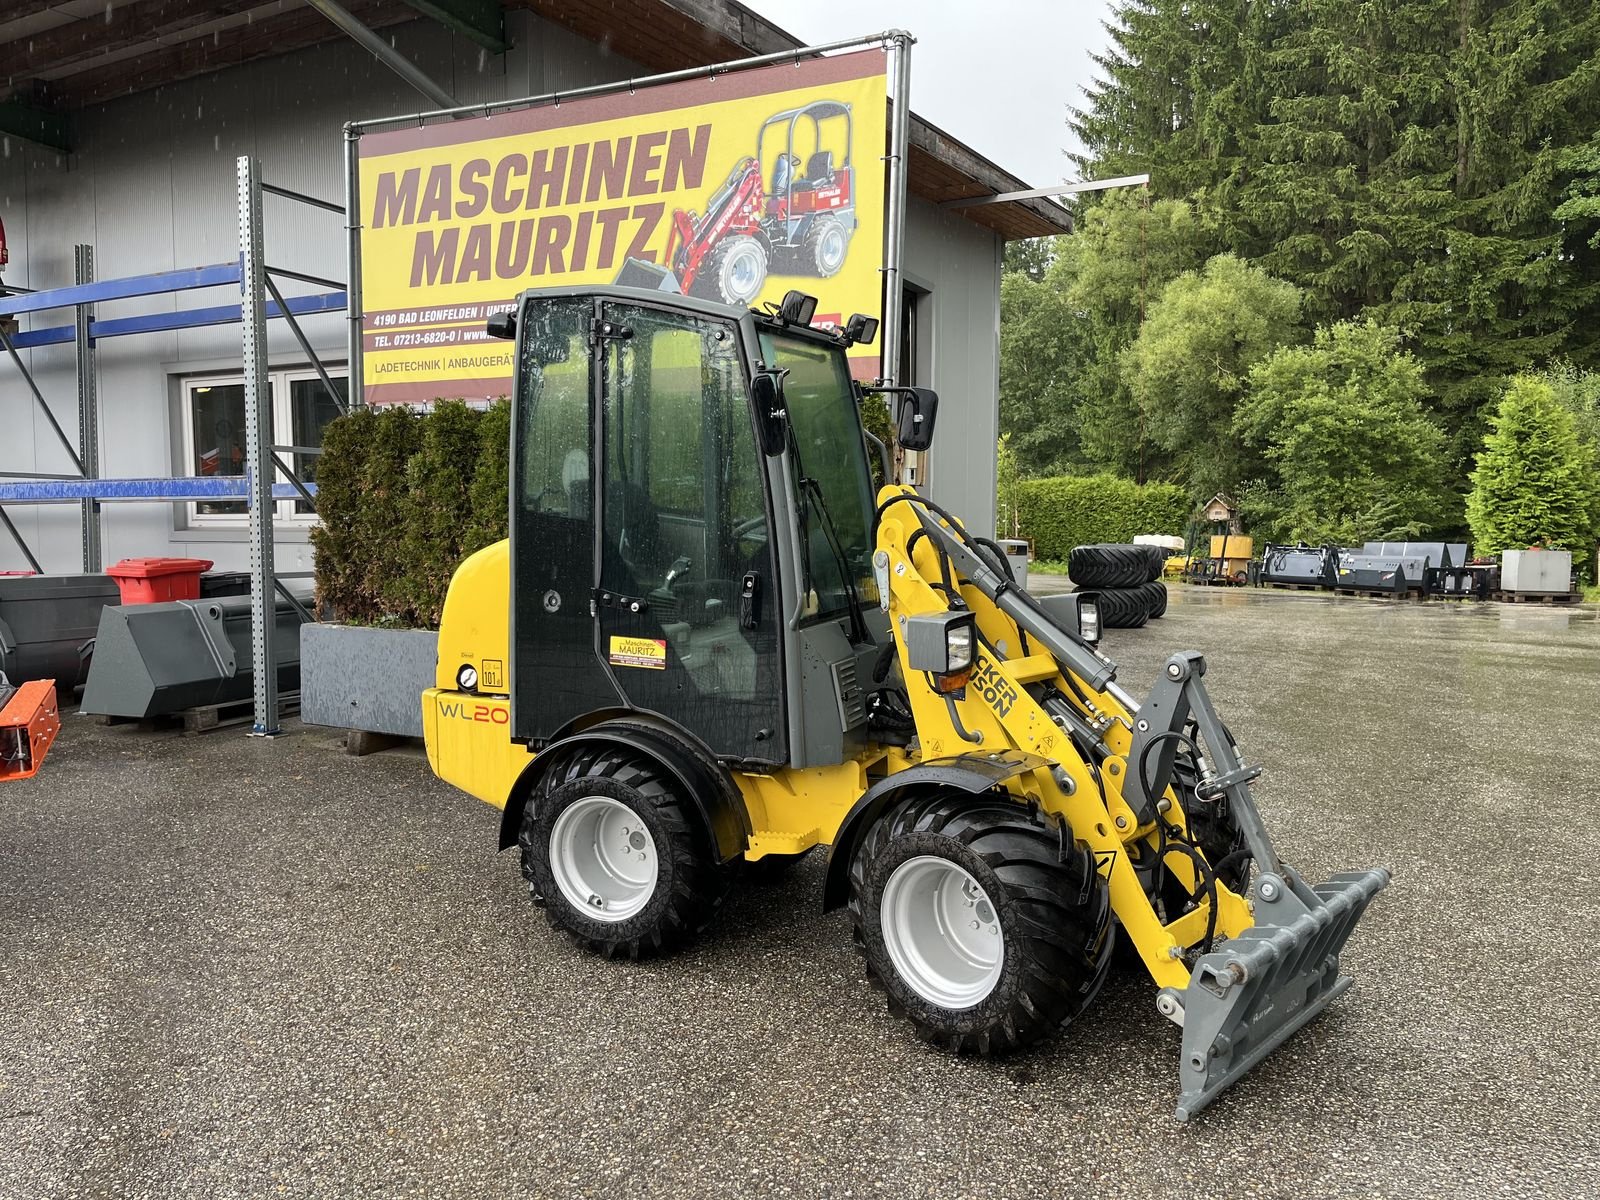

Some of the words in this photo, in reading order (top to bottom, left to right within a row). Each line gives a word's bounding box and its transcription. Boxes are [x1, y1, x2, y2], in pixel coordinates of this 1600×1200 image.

[372, 124, 712, 229] MASCHINEN
[409, 202, 666, 288] MAURITZ
[374, 314, 397, 326] 4190
[399, 312, 417, 324] BAD
[419, 306, 478, 322] LEONFELDEN
[486, 303, 518, 317] UNTER
[375, 336, 391, 347] TEL.
[394, 330, 456, 346] 07213-6820-0
[375, 359, 441, 373] LADETECHNIK
[619, 645, 656, 656] MAURITZ
[484, 671, 496, 685] 101
[976, 655, 1018, 707] CKER
[969, 671, 1011, 719] SON
[439, 701, 509, 724] WL20
